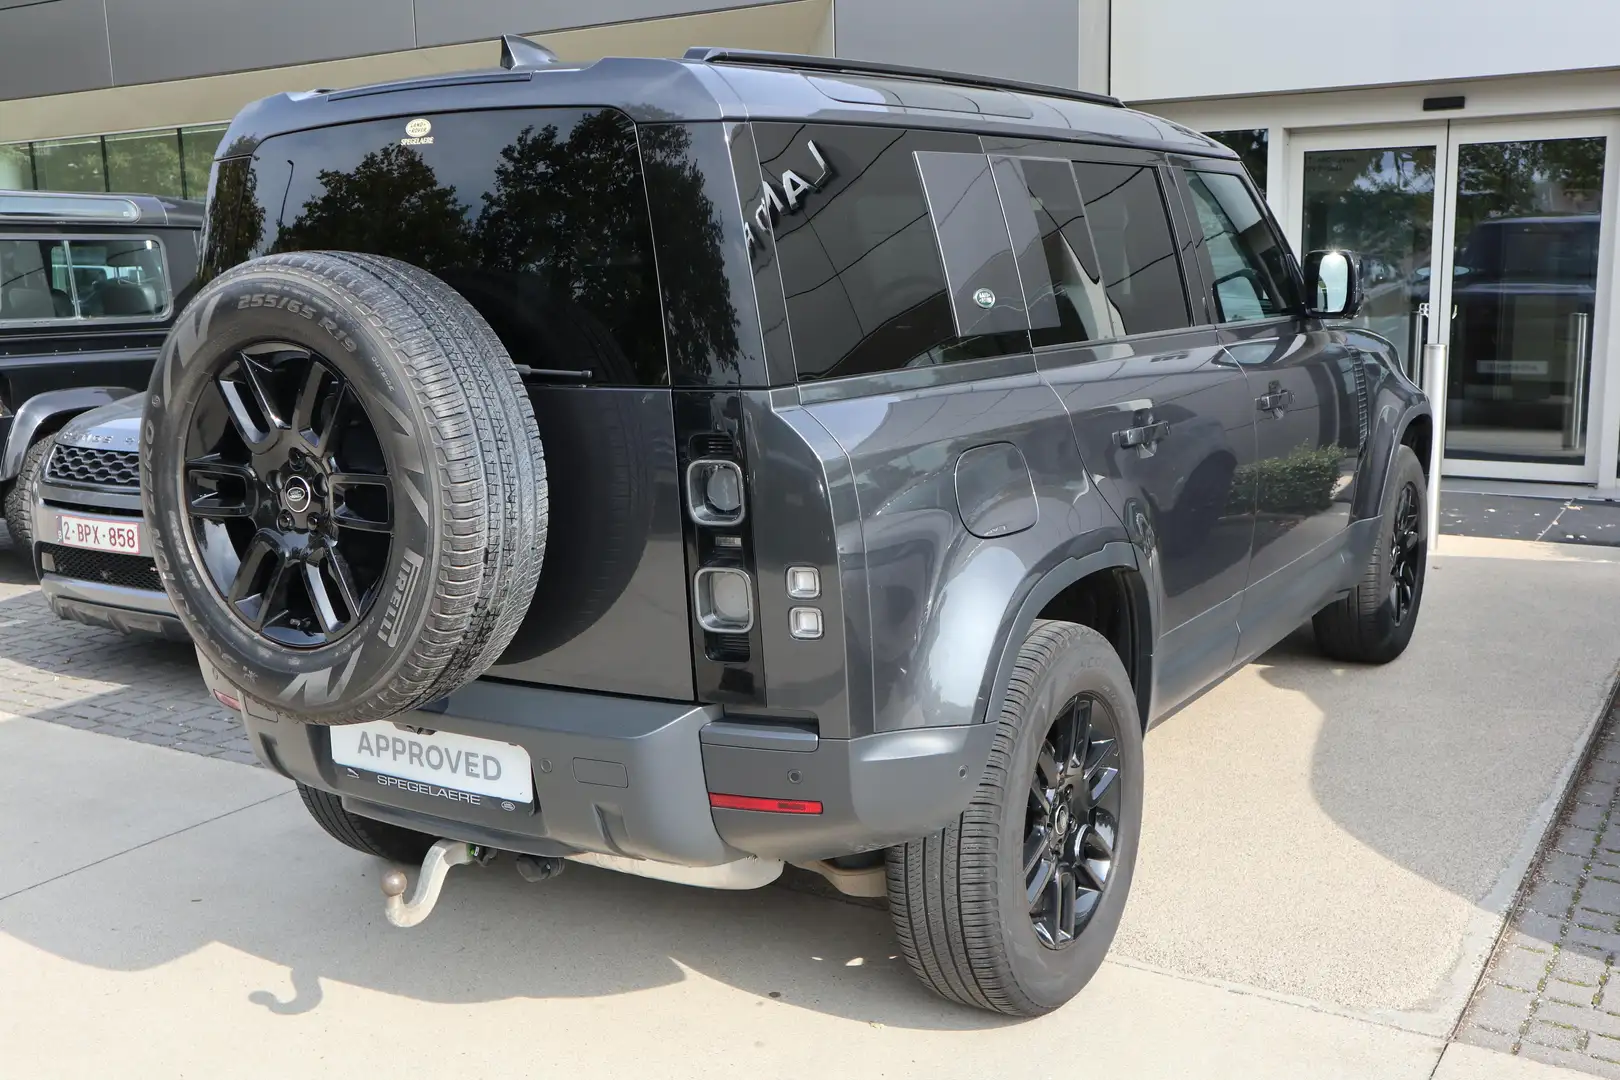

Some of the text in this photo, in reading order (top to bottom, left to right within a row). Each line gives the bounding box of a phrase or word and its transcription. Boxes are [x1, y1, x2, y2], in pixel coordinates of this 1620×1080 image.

[237, 293, 317, 320] 255/65
[318, 316, 358, 353] R19
[371, 356, 396, 392] OUTSIDE
[377, 546, 424, 648] PIRELLI
[357, 731, 502, 781] APPROVED
[377, 774, 481, 805] SPEGELAERE
